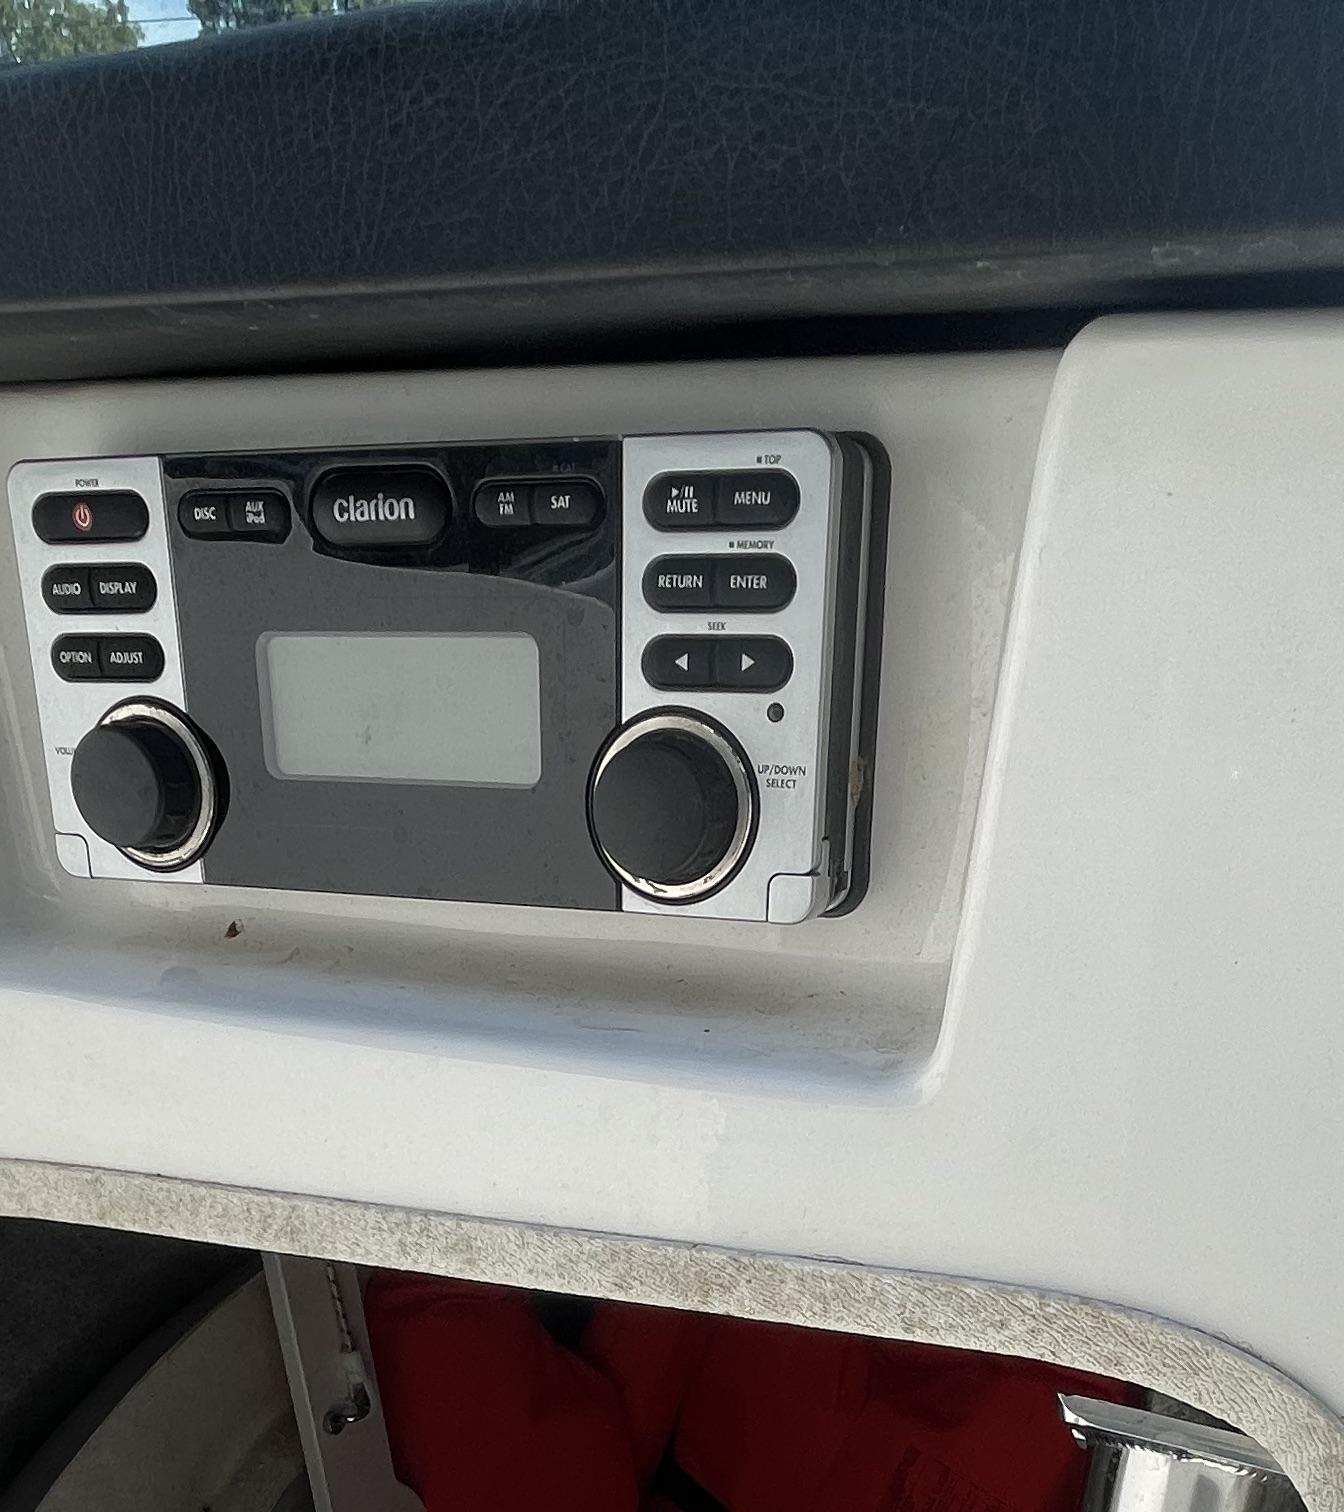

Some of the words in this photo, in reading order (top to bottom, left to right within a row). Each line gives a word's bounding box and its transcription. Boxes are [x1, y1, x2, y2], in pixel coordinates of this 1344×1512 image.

[764, 454, 782, 465] TOP
[74, 478, 100, 488] POWER
[497, 492, 515, 504] AM
[550, 494, 571, 510] SAT
[733, 490, 771, 506] MENU
[245, 501, 265, 512] AUX
[332, 493, 416, 524] clarion
[498, 504, 515, 516] FM
[666, 499, 699, 514] MUTE
[193, 507, 217, 521] DISC
[736, 539, 775, 551] MEMORY
[99, 581, 138, 595] DISPLAY
[657, 573, 704, 590] RETURN
[729, 574, 768, 590] ENTER
[52, 582, 82, 596] AUDIO
[707, 621, 727, 632] SEEK
[59, 651, 93, 665] OPTION
[109, 651, 144, 665] ADJUST
[757, 764, 807, 777] UP/DOWN
[765, 777, 797, 790] SELECT
